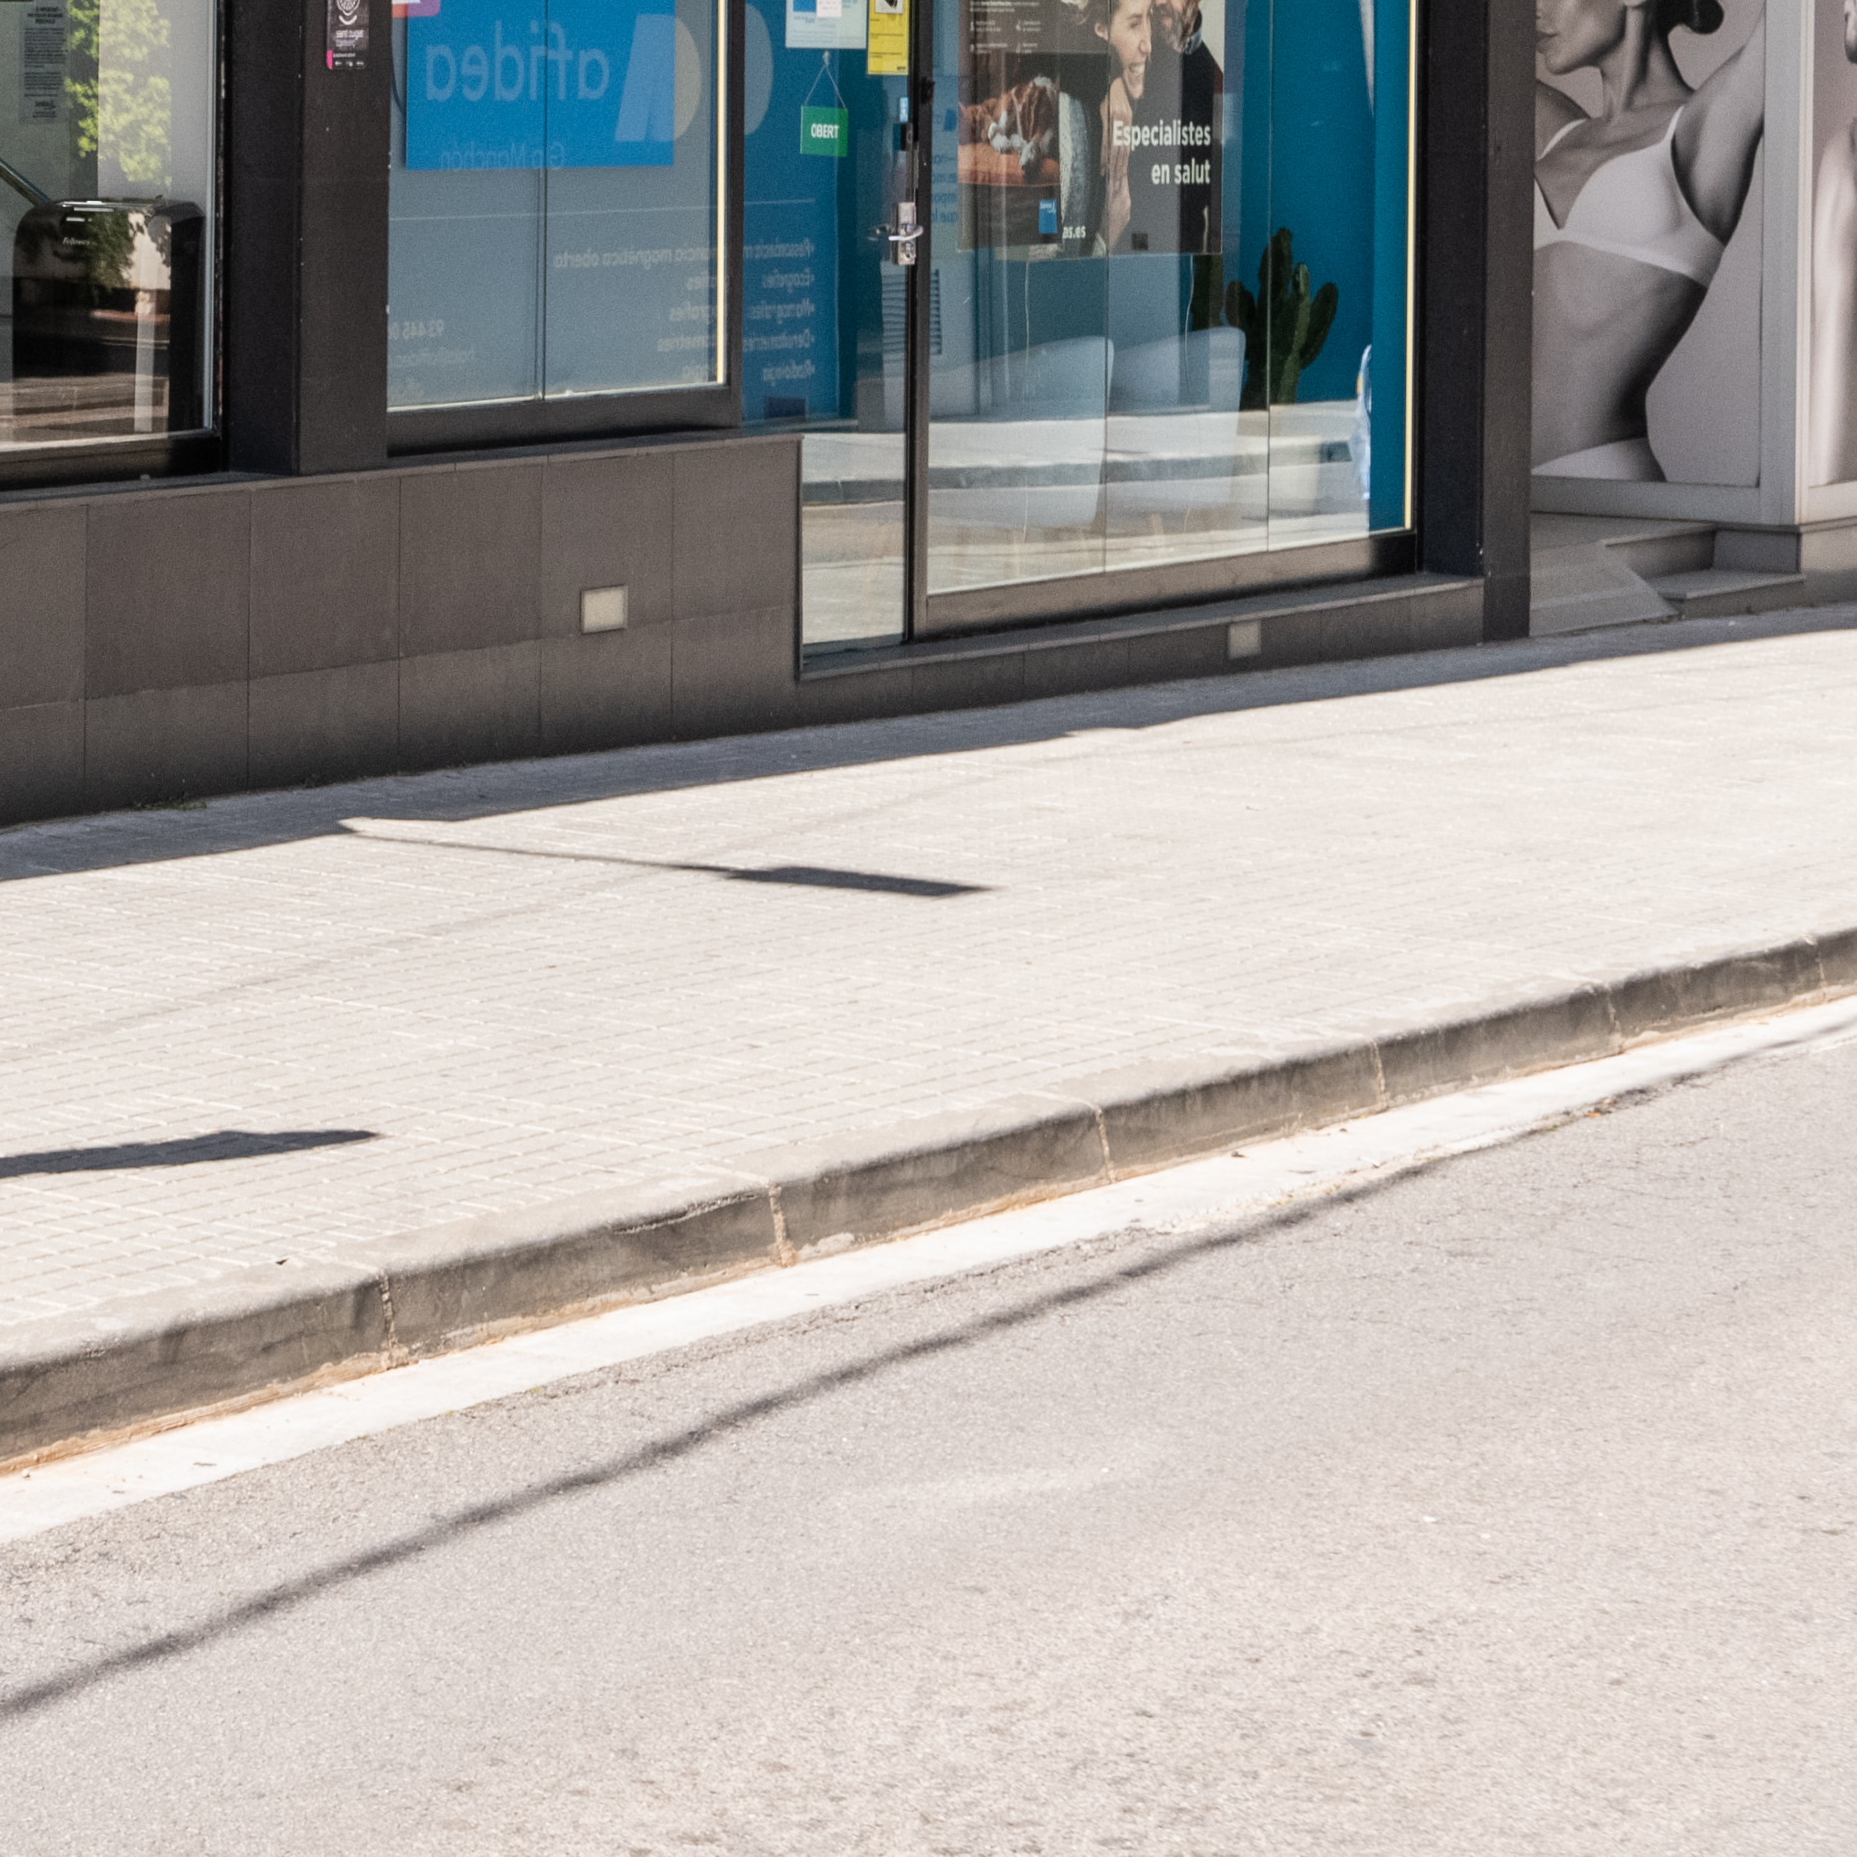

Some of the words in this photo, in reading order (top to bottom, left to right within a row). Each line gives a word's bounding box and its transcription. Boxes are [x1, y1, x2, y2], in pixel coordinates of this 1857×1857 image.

[810, 123, 840, 139] OBERT
[1113, 120, 1211, 151] Especialistes
[1152, 163, 1170, 185] en
[1174, 159, 1212, 186] salut
